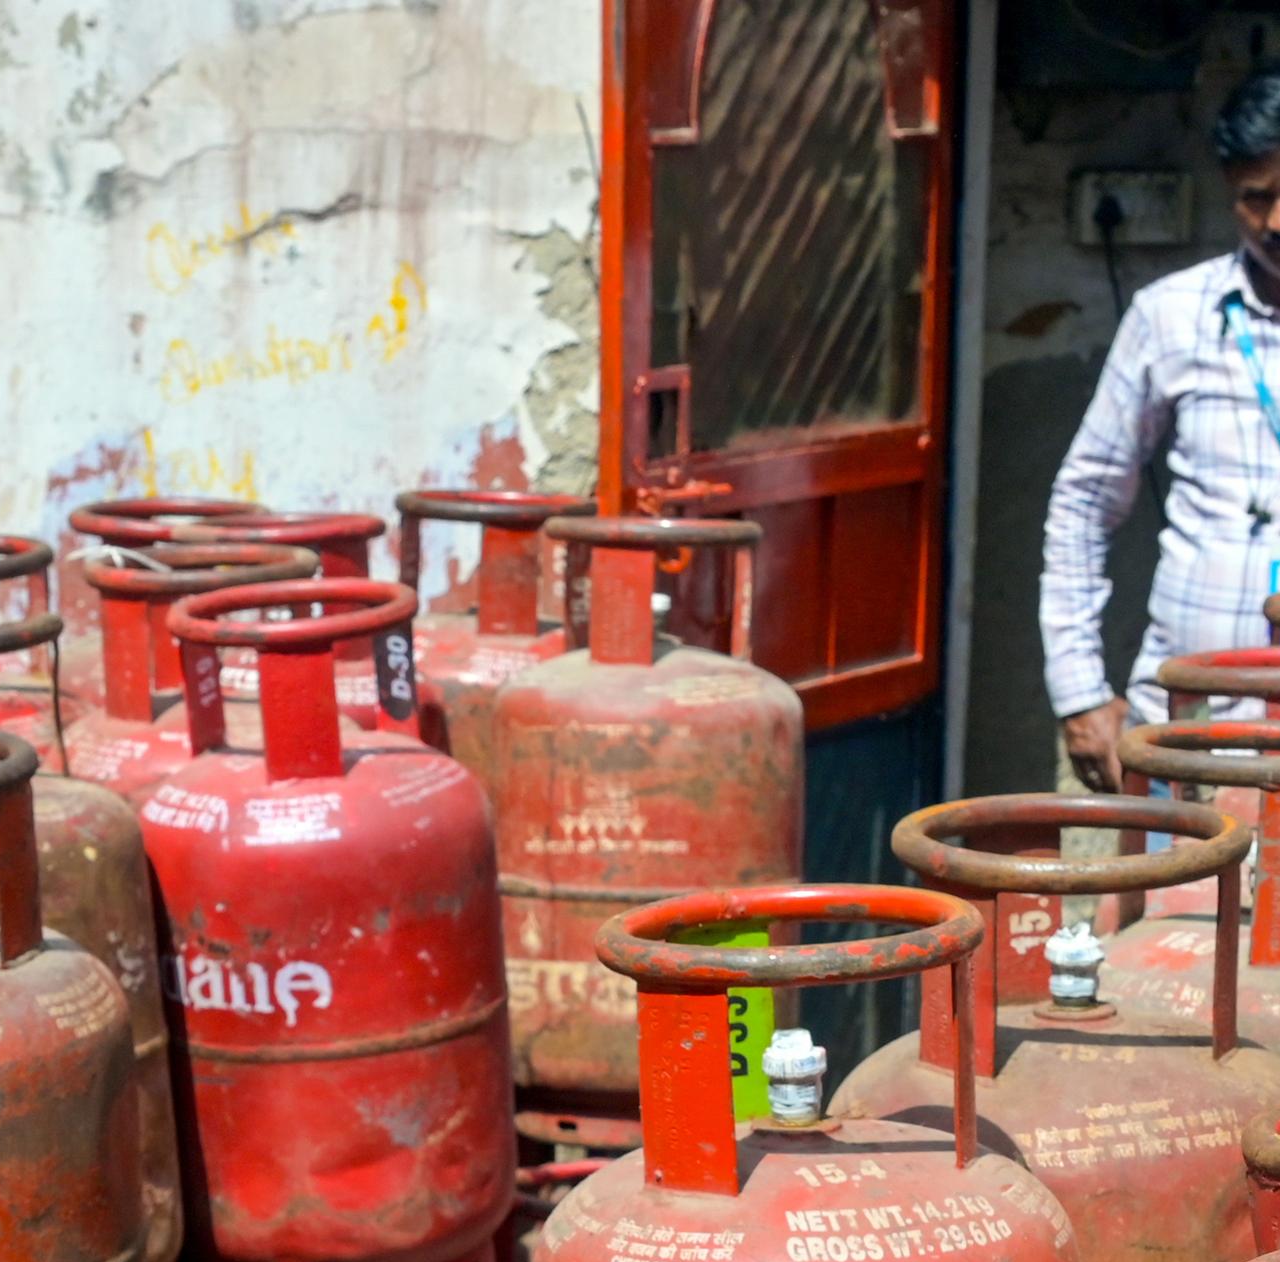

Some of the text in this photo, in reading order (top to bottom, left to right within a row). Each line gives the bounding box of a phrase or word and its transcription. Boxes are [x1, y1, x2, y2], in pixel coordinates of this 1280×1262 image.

[386, 635, 413, 702] D-30
[1007, 892, 1052, 956] 15.
[794, 1159, 888, 1188] 15.4
[784, 1208, 858, 1234] NETT
[863, 1204, 913, 1232] WT.
[912, 1196, 966, 1224] 14.2
[883, 1228, 934, 1260] WT.
[934, 1222, 987, 1254] 29.6
